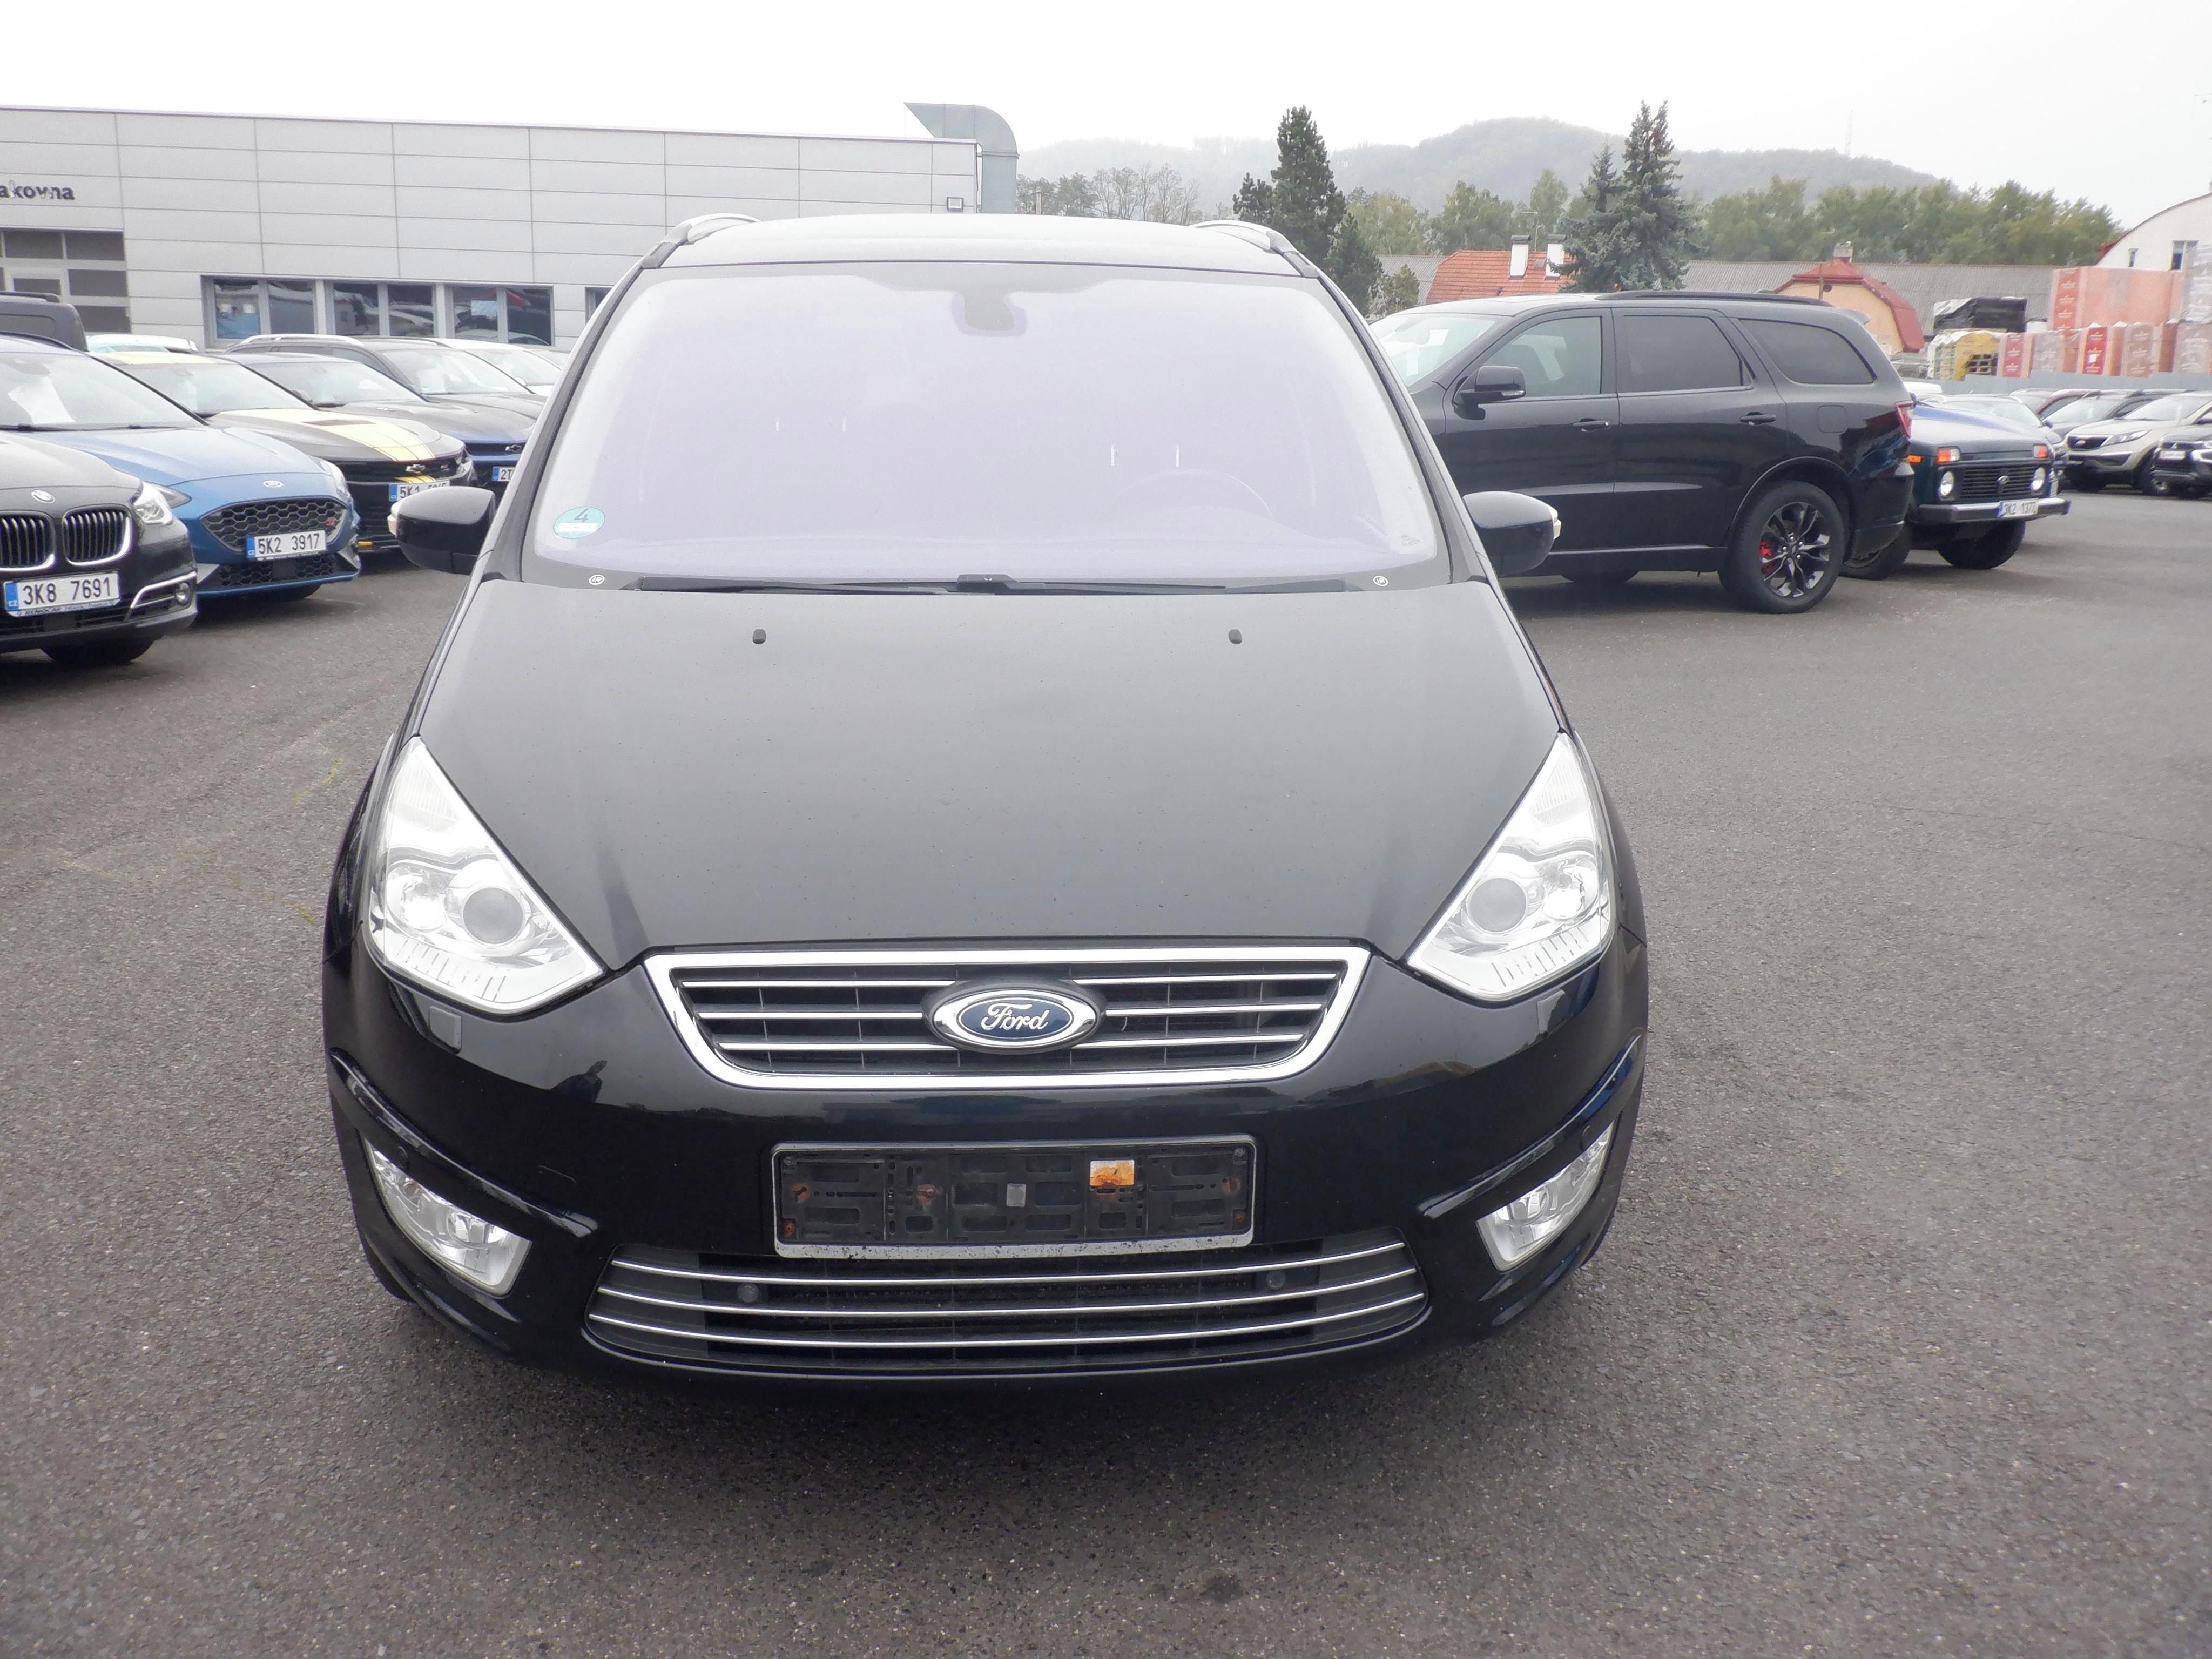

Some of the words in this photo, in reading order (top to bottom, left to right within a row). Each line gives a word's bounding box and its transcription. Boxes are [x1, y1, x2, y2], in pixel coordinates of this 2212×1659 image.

[574, 508, 589, 522] 4
[258, 537, 281, 554] 5K2
[291, 533, 320, 550] 3917
[23, 583, 56, 605] 3K8
[70, 577, 111, 601] 7691
[981, 1003, 1050, 1030] Ford
